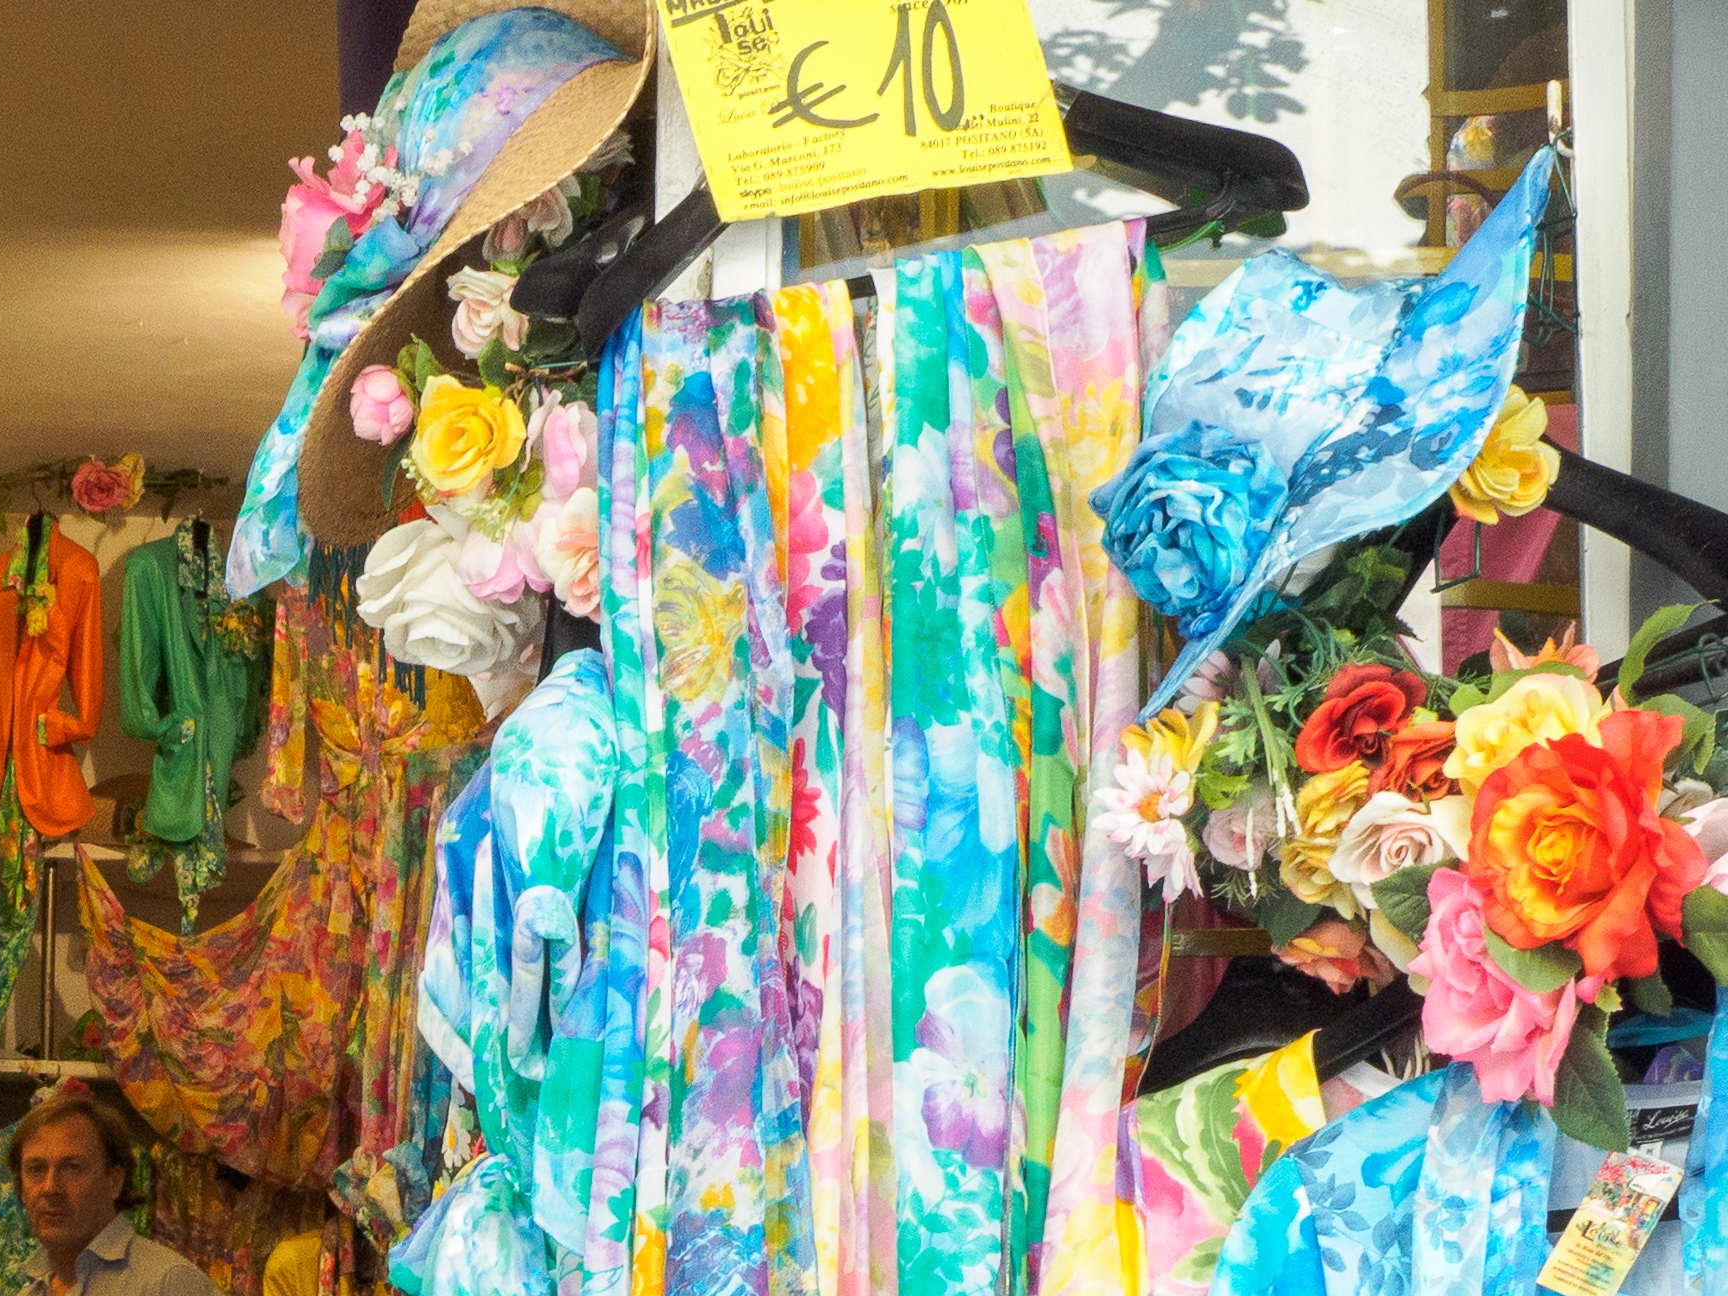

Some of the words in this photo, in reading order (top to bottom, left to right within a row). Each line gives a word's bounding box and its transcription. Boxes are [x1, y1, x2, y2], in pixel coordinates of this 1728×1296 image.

[738, 84, 781, 99] positano
[990, 100, 1036, 113] Boutique
[1028, 112, 1040, 124] 22
[727, 140, 792, 162] Laboratorio
[803, 129, 845, 146] Factory
[920, 136, 951, 150] 84017
[955, 131, 1017, 146] POSITANO
[1020, 127, 1044, 139] (SA)
[988, 145, 1007, 156] 089
[1009, 141, 1047, 154] 875192
[731, 162, 751, 174] Via
[753, 160, 766, 171] G.
[769, 149, 821, 167] Marconi,
[823, 142, 843, 156] 173
[931, 156, 1051, 178] www.louisepositano.com
[763, 169, 783, 182] 089
[785, 161, 826, 178] 875909
